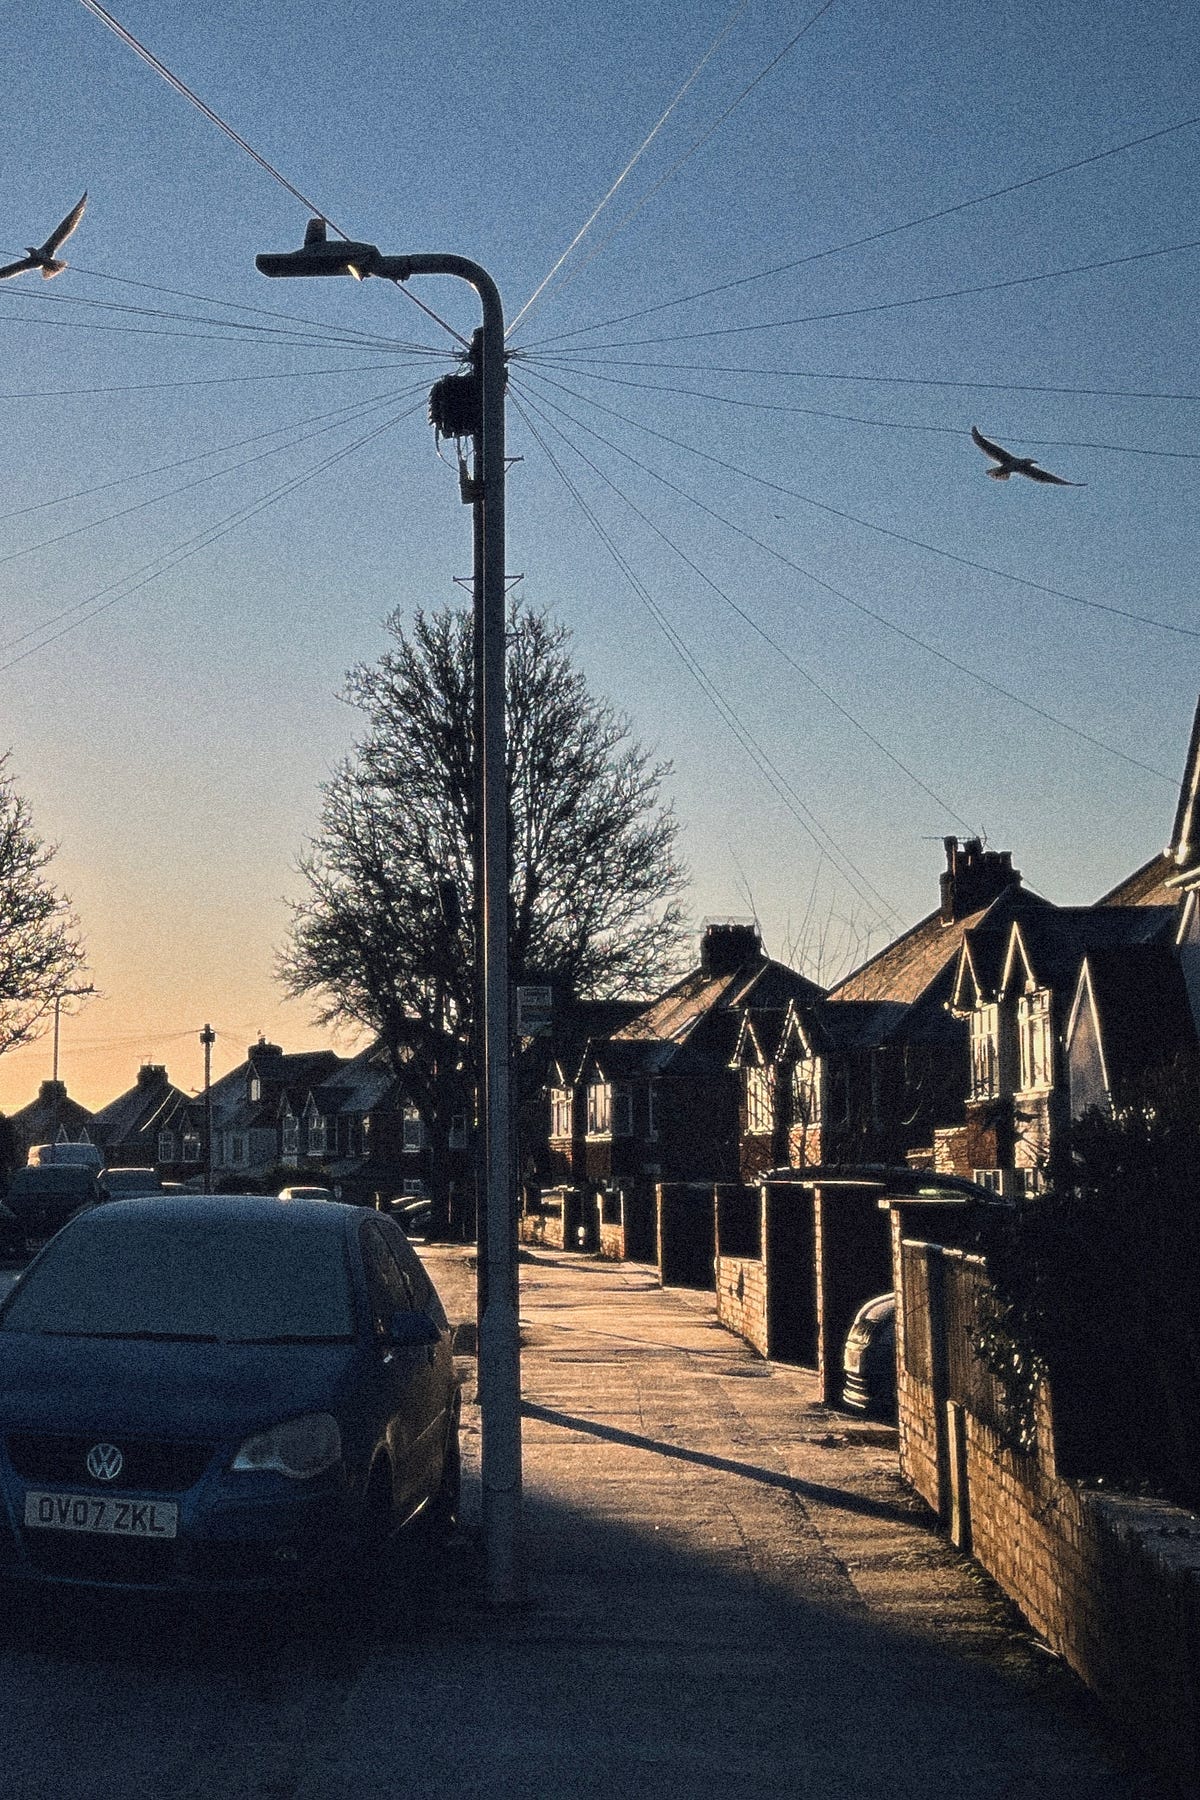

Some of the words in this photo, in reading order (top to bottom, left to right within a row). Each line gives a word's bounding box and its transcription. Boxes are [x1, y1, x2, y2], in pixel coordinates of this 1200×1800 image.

[87, 1443, 123, 1480] VW
[39, 1496, 107, 1527] OV07
[114, 1502, 166, 1532] ZKL
